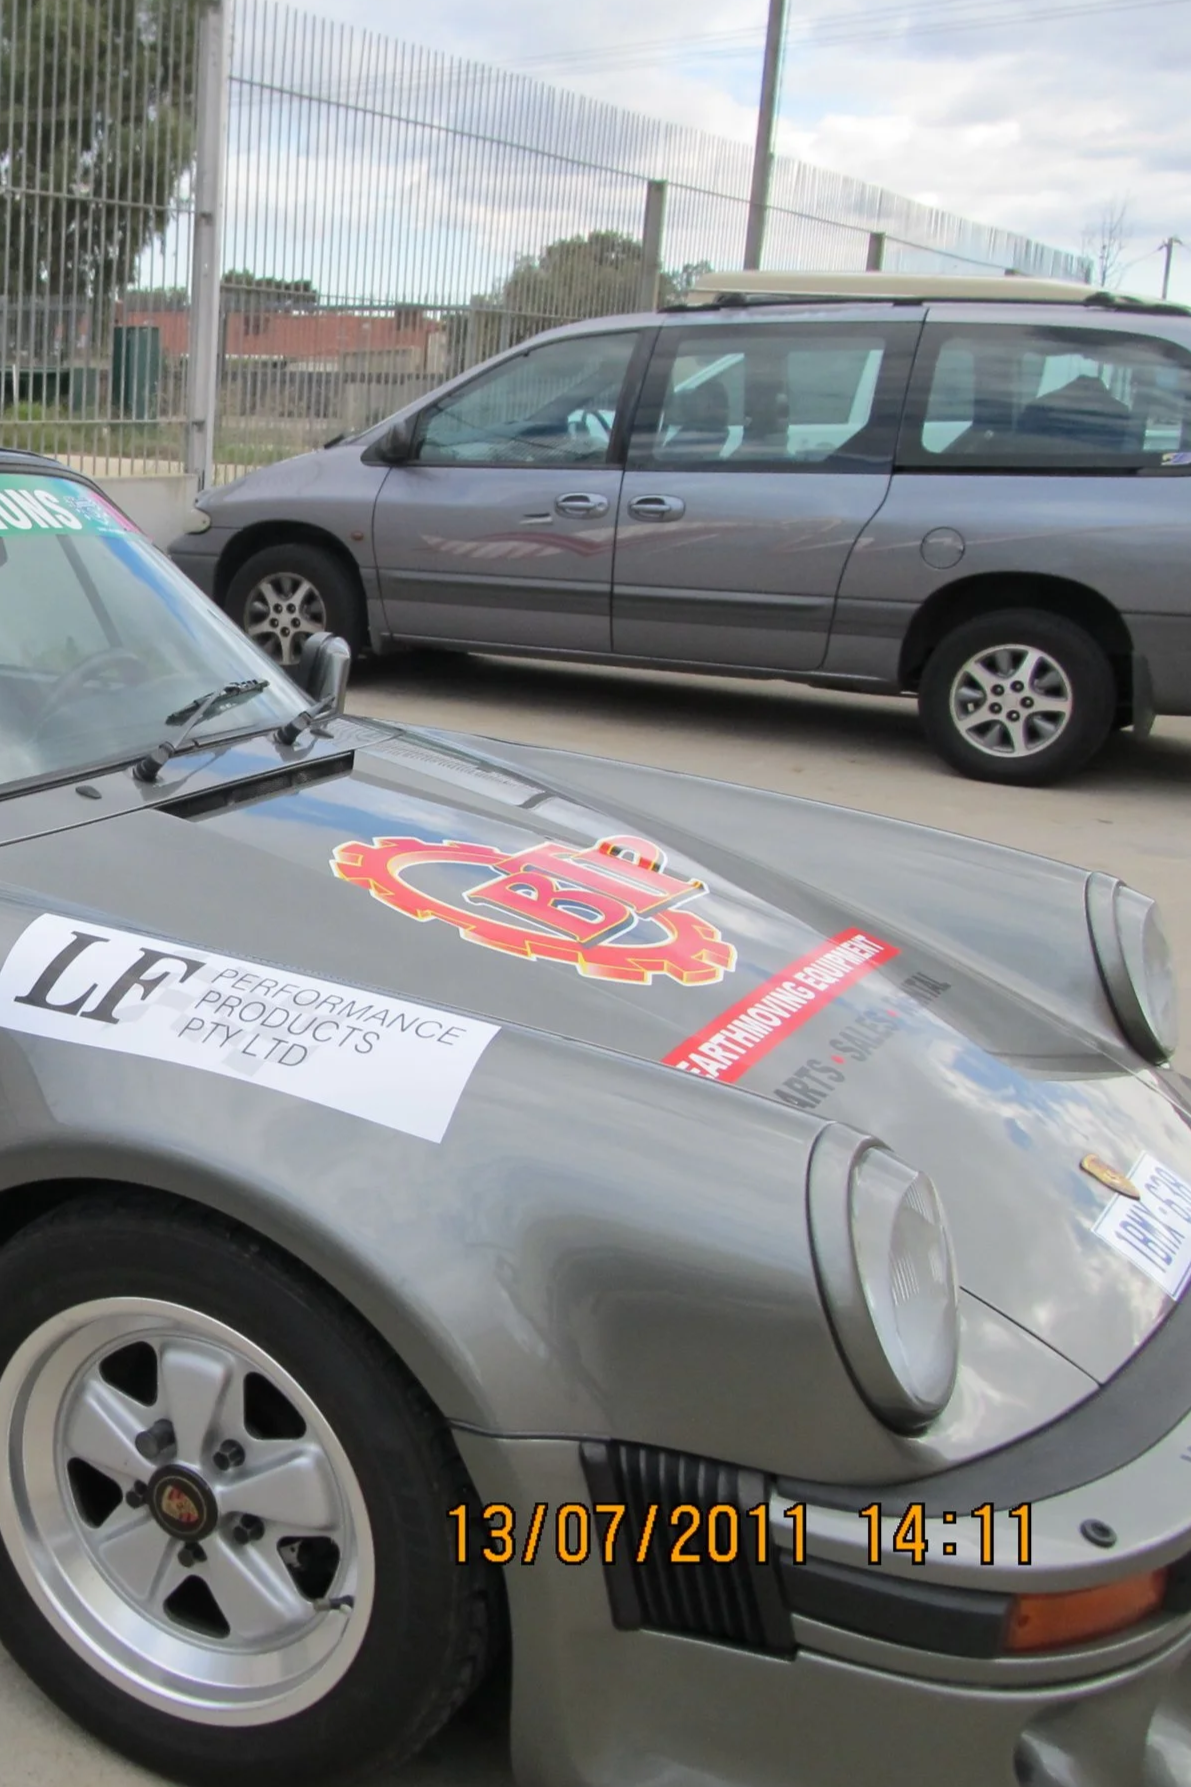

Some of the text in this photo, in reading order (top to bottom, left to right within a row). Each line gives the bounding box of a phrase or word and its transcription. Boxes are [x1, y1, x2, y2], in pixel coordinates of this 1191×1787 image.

[14, 931, 206, 1025] LF
[793, 934, 885, 992] EQUIPMENT
[178, 1016, 308, 1067] PTY LTD
[195, 990, 380, 1054] PRODUCTS
[211, 968, 467, 1046] PERFORMANCE
[772, 1059, 846, 1109] ARTS
[829, 1010, 899, 1061] SALES
